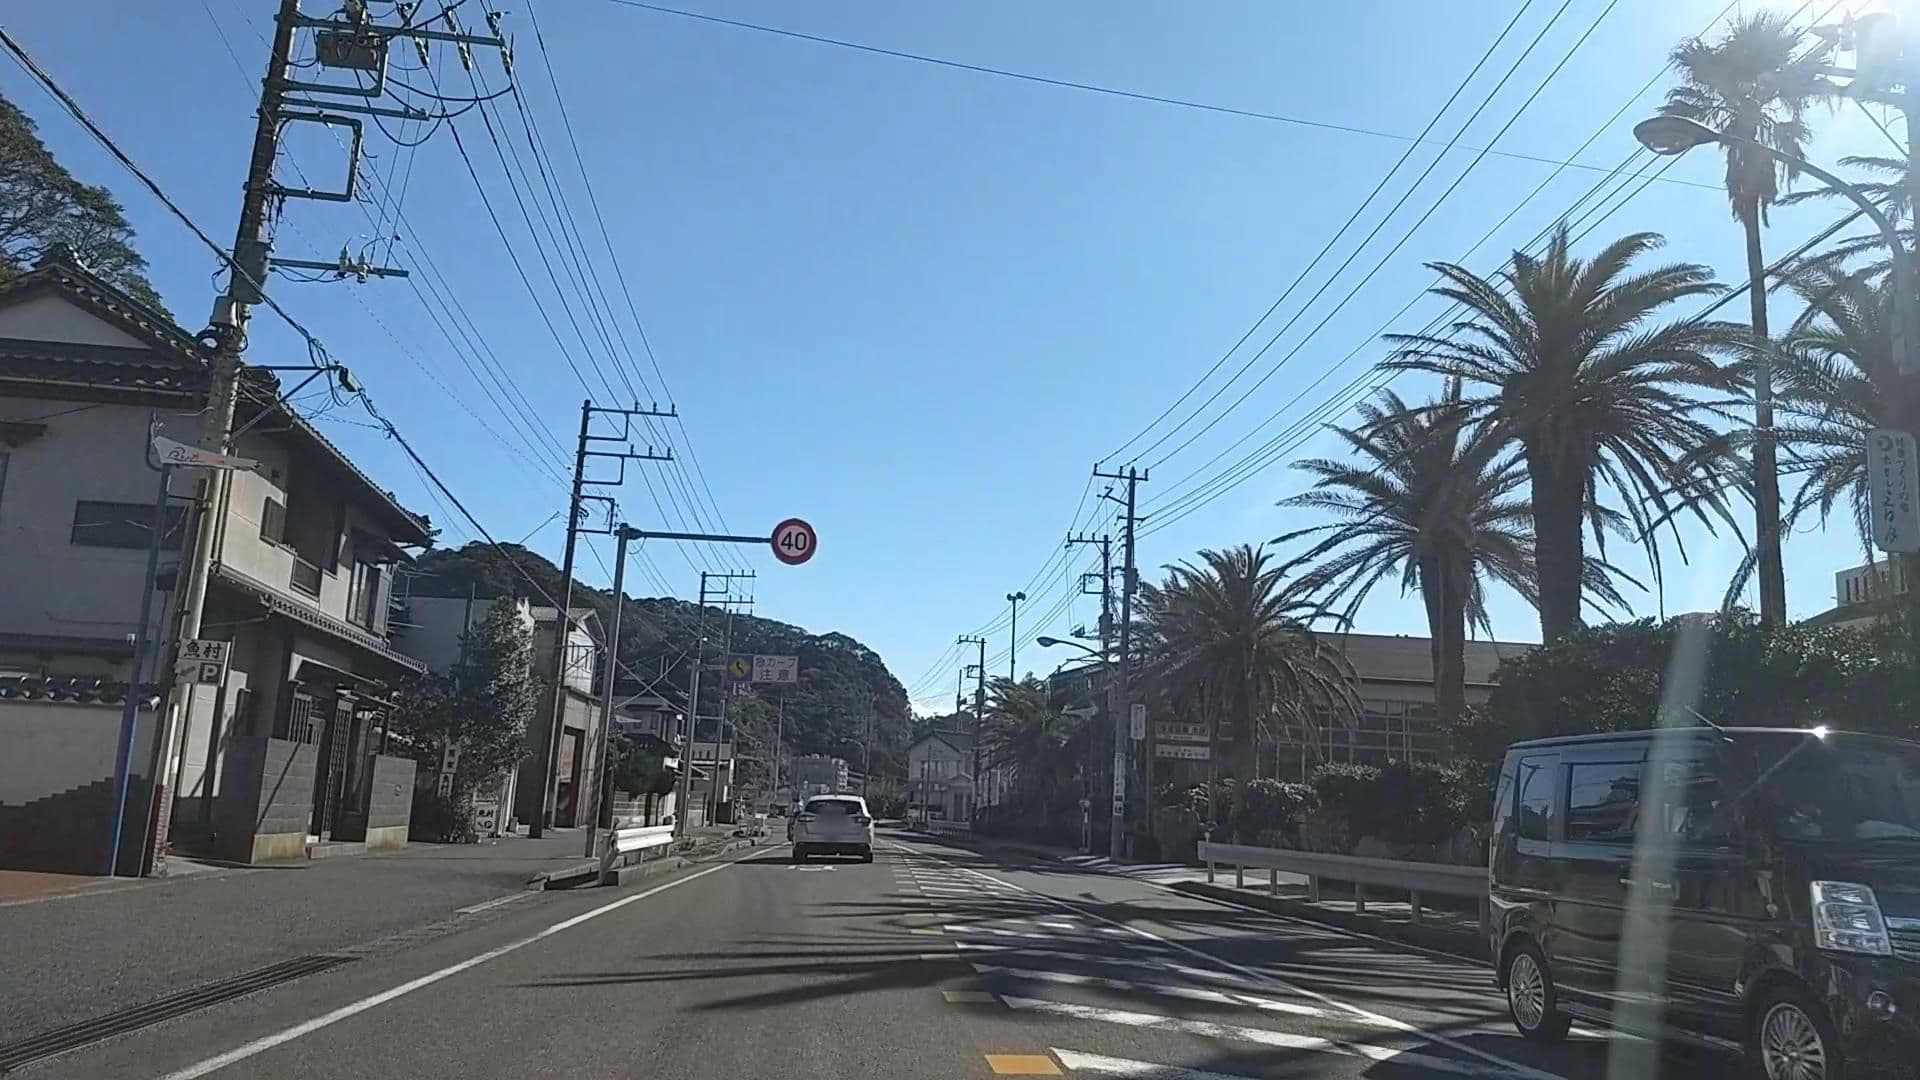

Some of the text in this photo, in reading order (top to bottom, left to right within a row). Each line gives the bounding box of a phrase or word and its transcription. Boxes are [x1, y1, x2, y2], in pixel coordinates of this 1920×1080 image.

[780, 531, 807, 551] 40
[183, 640, 223, 659] 魚村
[202, 664, 218, 681] P
